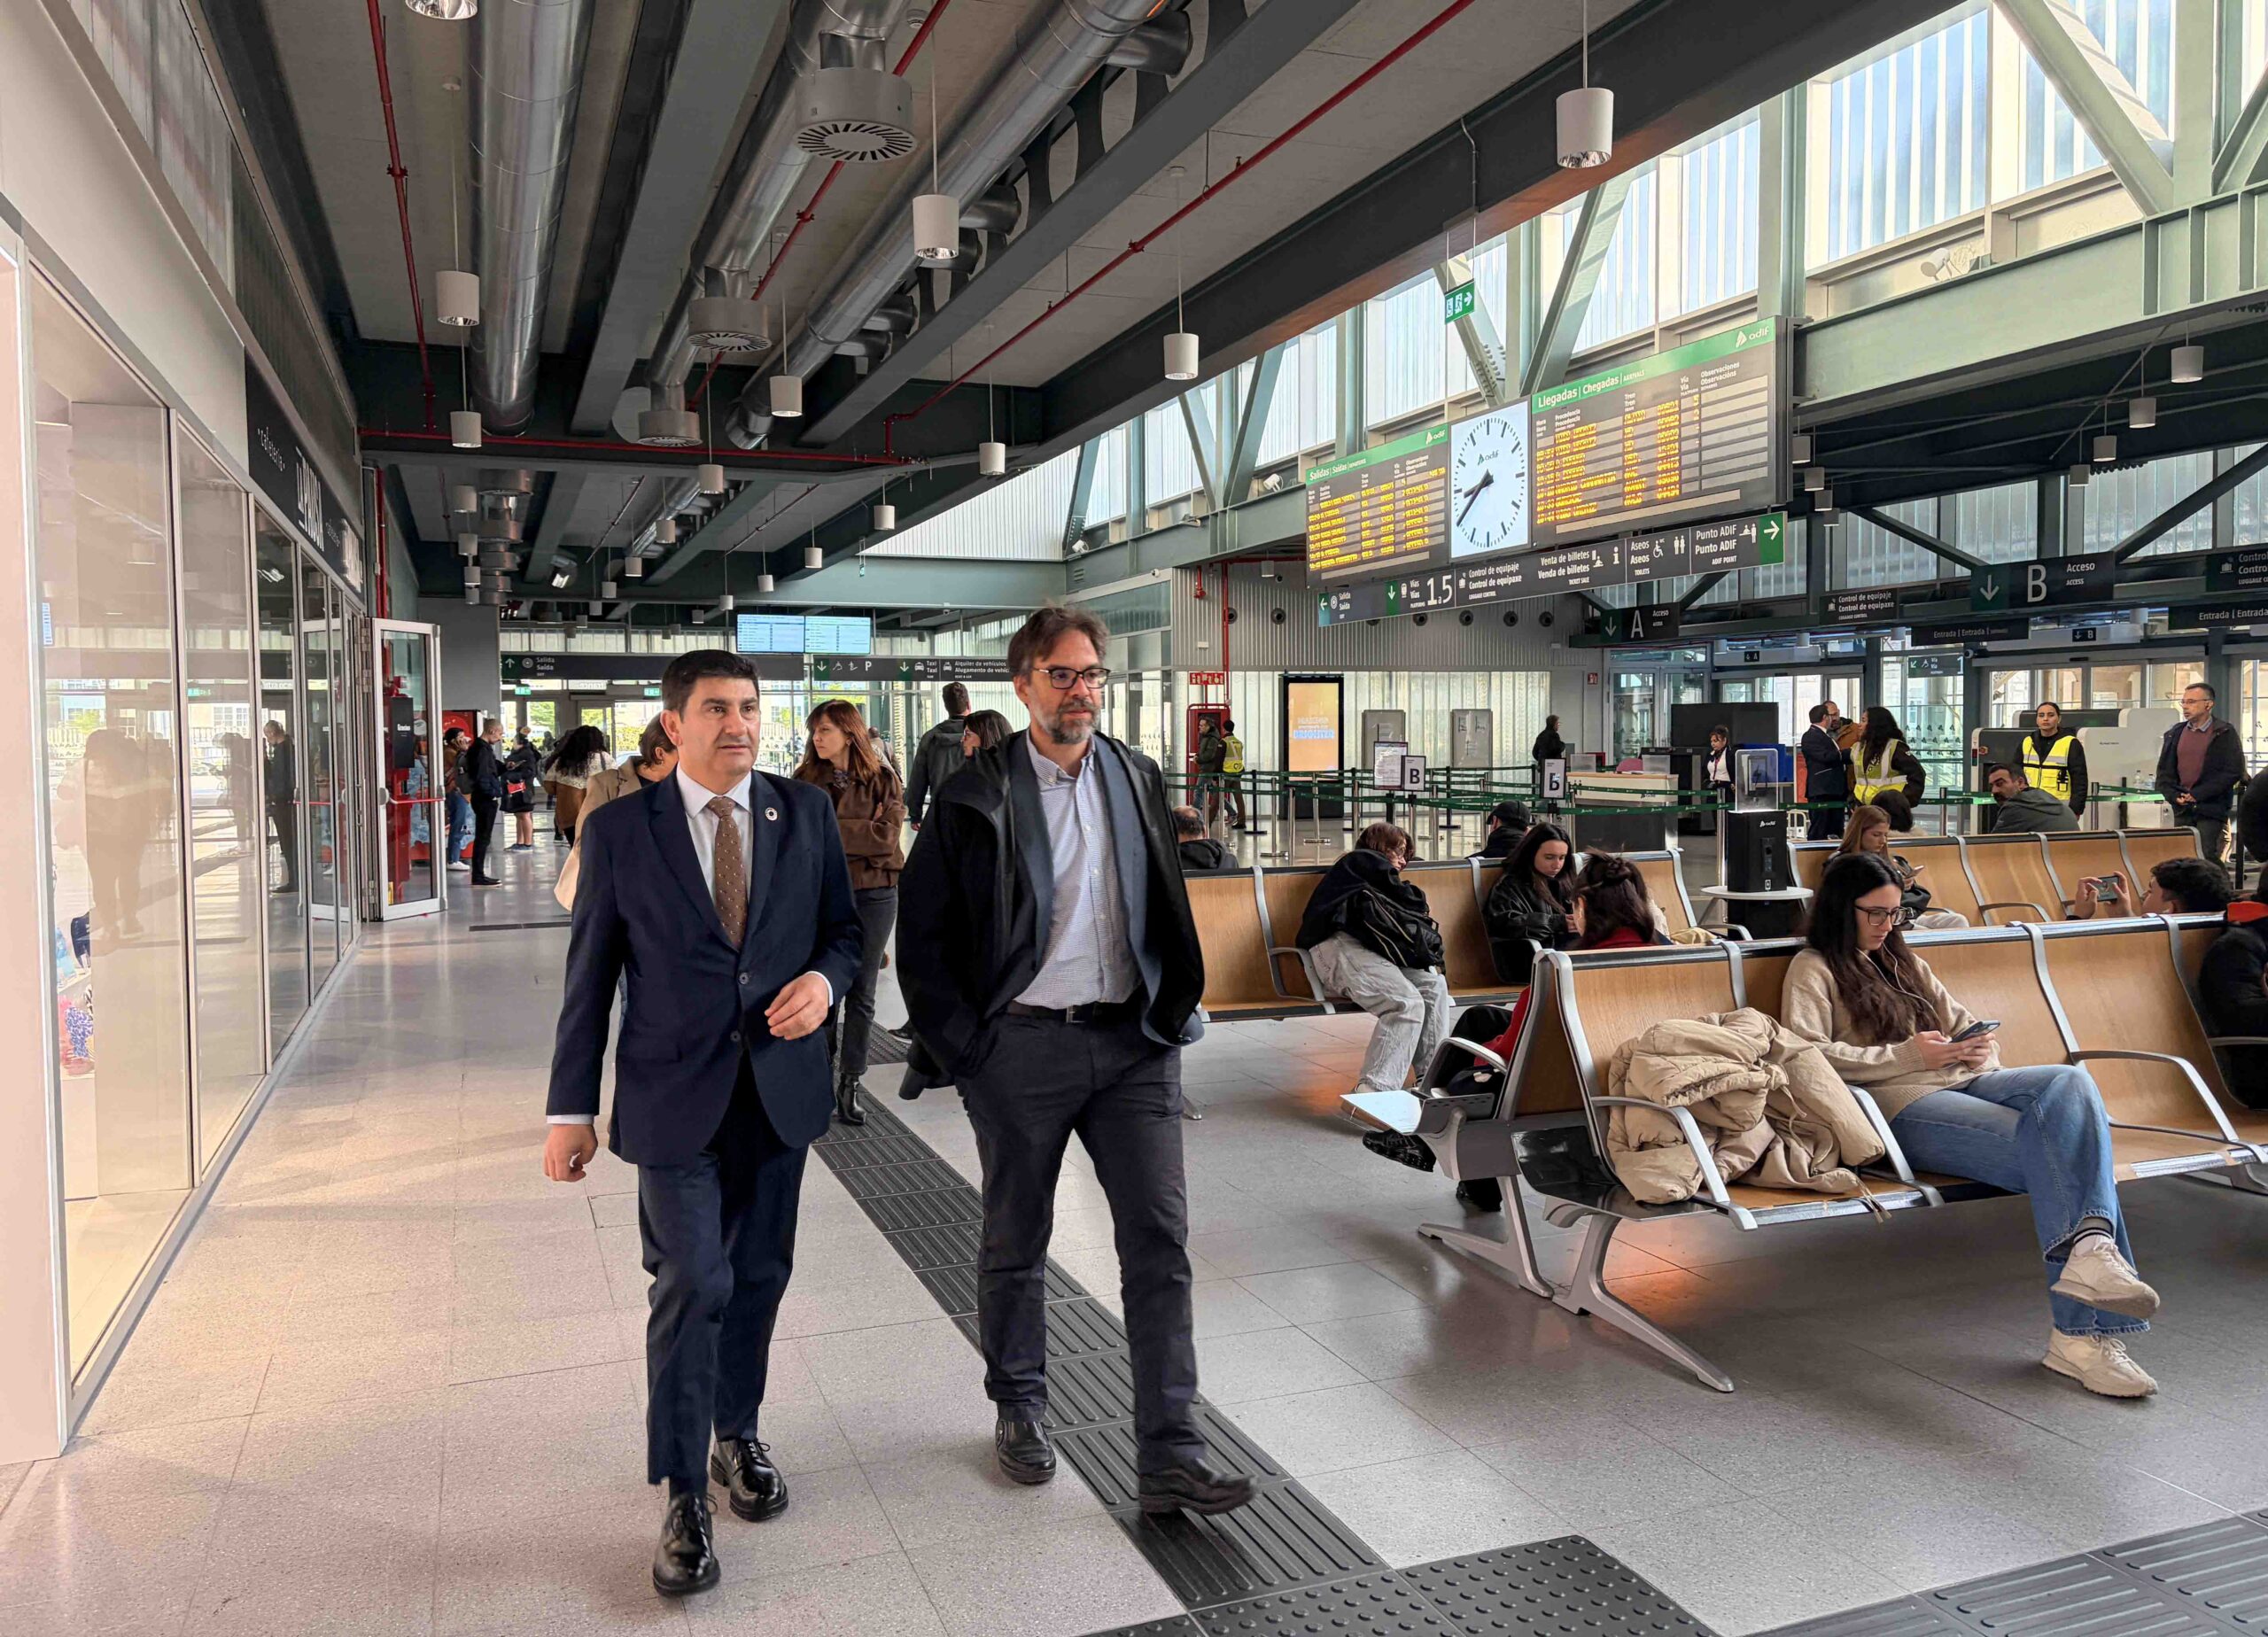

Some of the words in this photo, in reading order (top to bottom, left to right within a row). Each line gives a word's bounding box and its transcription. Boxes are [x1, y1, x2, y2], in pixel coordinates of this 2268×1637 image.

[1749, 326, 1769, 341] adif
[1701, 361, 1740, 378] Observaciones
[1538, 387, 1578, 408] Llegadas
[1582, 376, 1619, 395] Chegadas
[1623, 369, 1645, 382] ARRIVALS
[1485, 450, 1499, 462] adif
[1309, 469, 1330, 481] Salidas
[1696, 529, 1718, 540] Punto
[1720, 524, 1736, 537] ADIF
[1631, 540, 1650, 551] Aseos
[1695, 544, 1718, 555] Punto
[1720, 539, 1736, 552] ADIF
[1540, 555, 1557, 567] Venta
[1558, 554, 1566, 563] de
[1567, 550, 1589, 562] billetes
[1630, 554, 1650, 565] Aseos
[1469, 566, 1487, 578] Control
[1488, 565, 1495, 575] de
[1495, 562, 1519, 575] equipaje
[1538, 568, 1557, 580] Venda
[1558, 566, 1566, 577] de
[1567, 563, 1589, 576] billetes
[1469, 578, 1488, 590] Control
[1489, 577, 1495, 586] de
[1496, 574, 1522, 586] equipaxe
[2027, 564, 2047, 603] B
[2066, 562, 2095, 572] Acceso
[1339, 592, 1351, 601] Salida
[1410, 590, 1420, 599] Vías
[1838, 594, 1858, 603] Control
[1867, 591, 1891, 601] equipaje
[1339, 601, 1350, 610] Saída
[1838, 603, 1858, 613] Control
[1868, 601, 1895, 611] equipaxe
[2199, 611, 2229, 621] Entrada
[1631, 609, 1644, 639] A
[1933, 630, 1956, 639] Entrada
[1961, 628, 1984, 637] Entrada
[1956, 656, 1964, 675] 1
[1410, 768, 1420, 784] B
